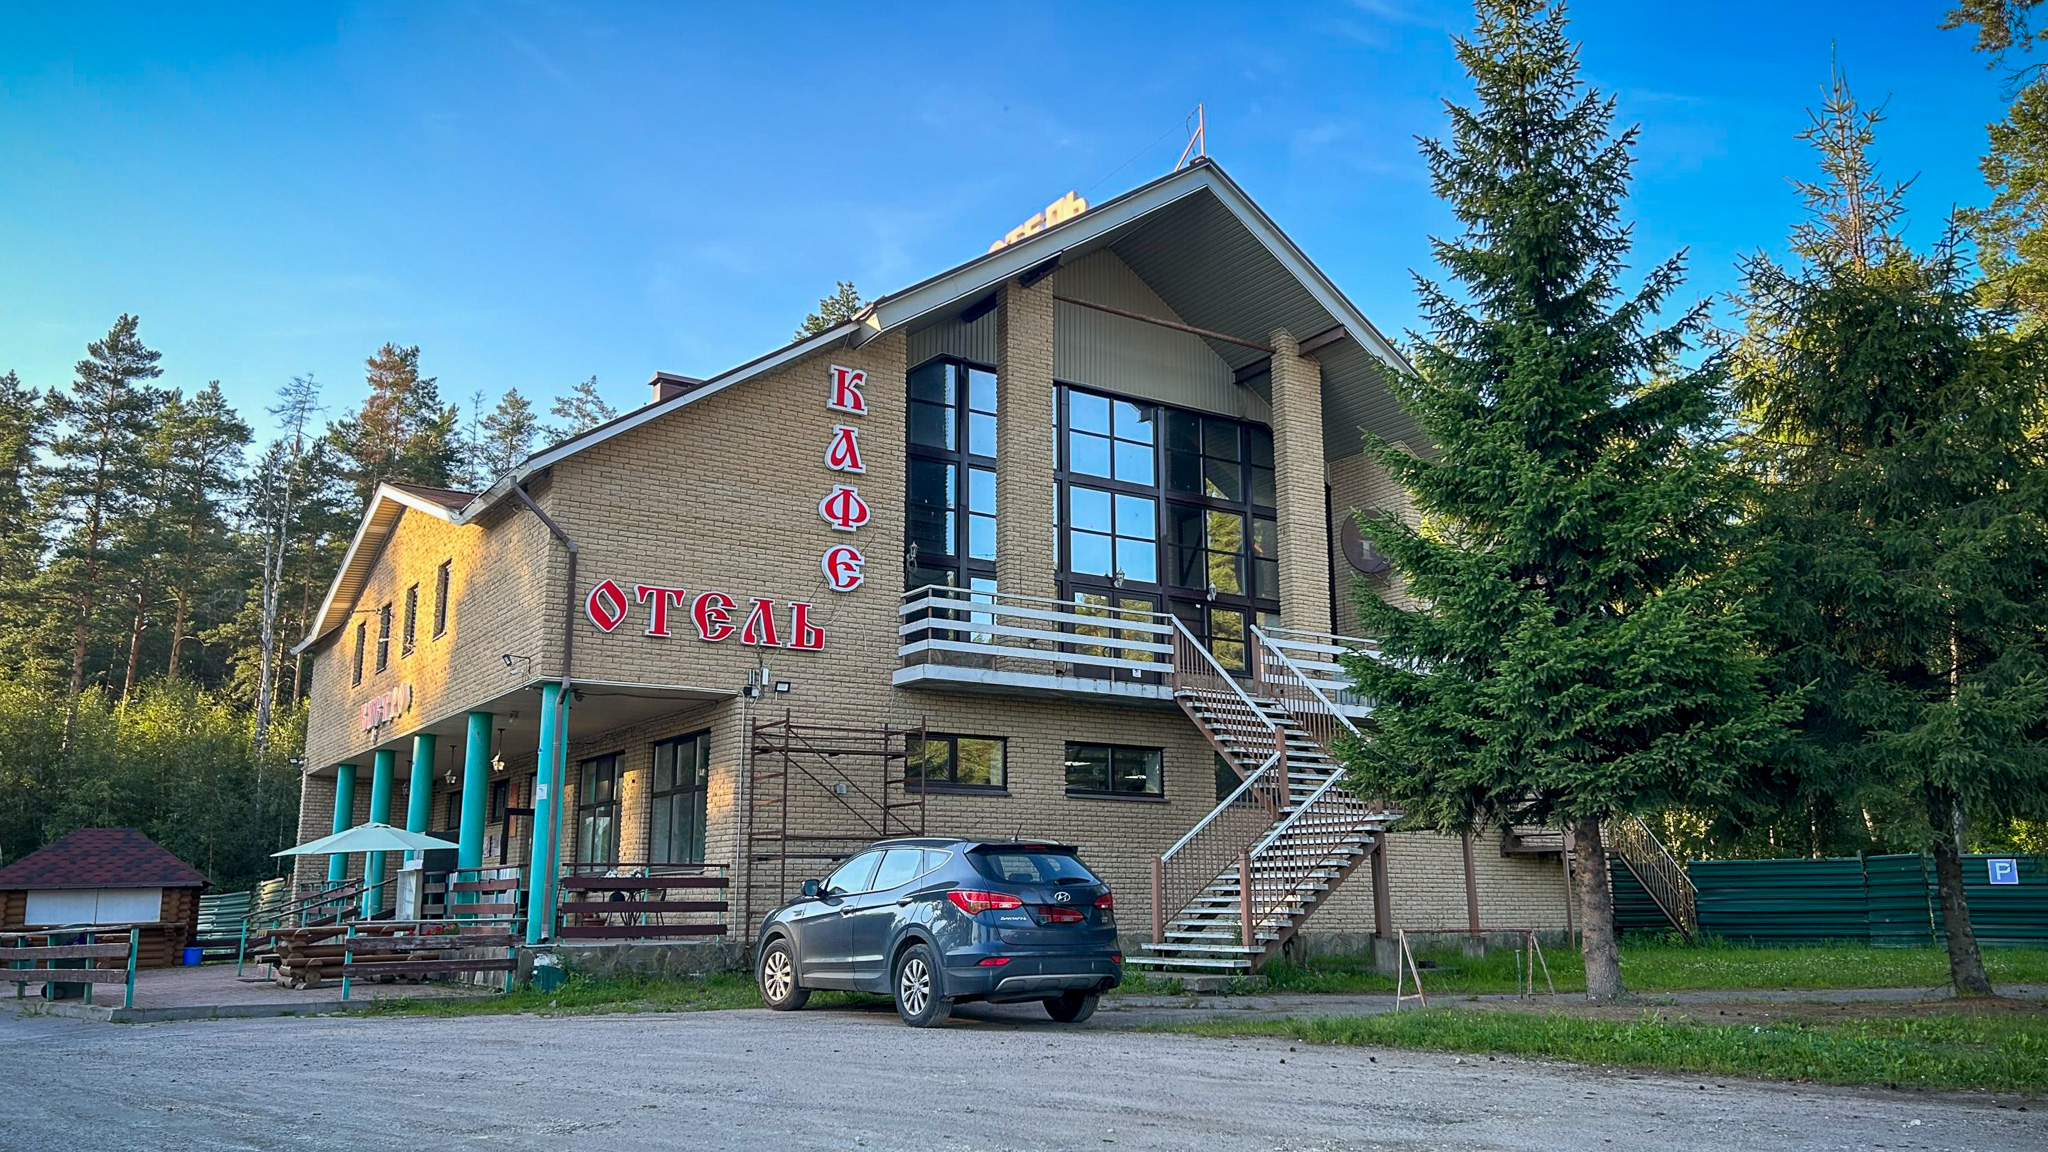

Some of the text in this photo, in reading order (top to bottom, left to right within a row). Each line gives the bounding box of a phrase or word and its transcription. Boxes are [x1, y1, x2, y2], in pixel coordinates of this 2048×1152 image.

[819, 364, 871, 593] КАФЕ
[585, 579, 826, 651] ОТЕЛЬ
[1995, 863, 2011, 880] P
